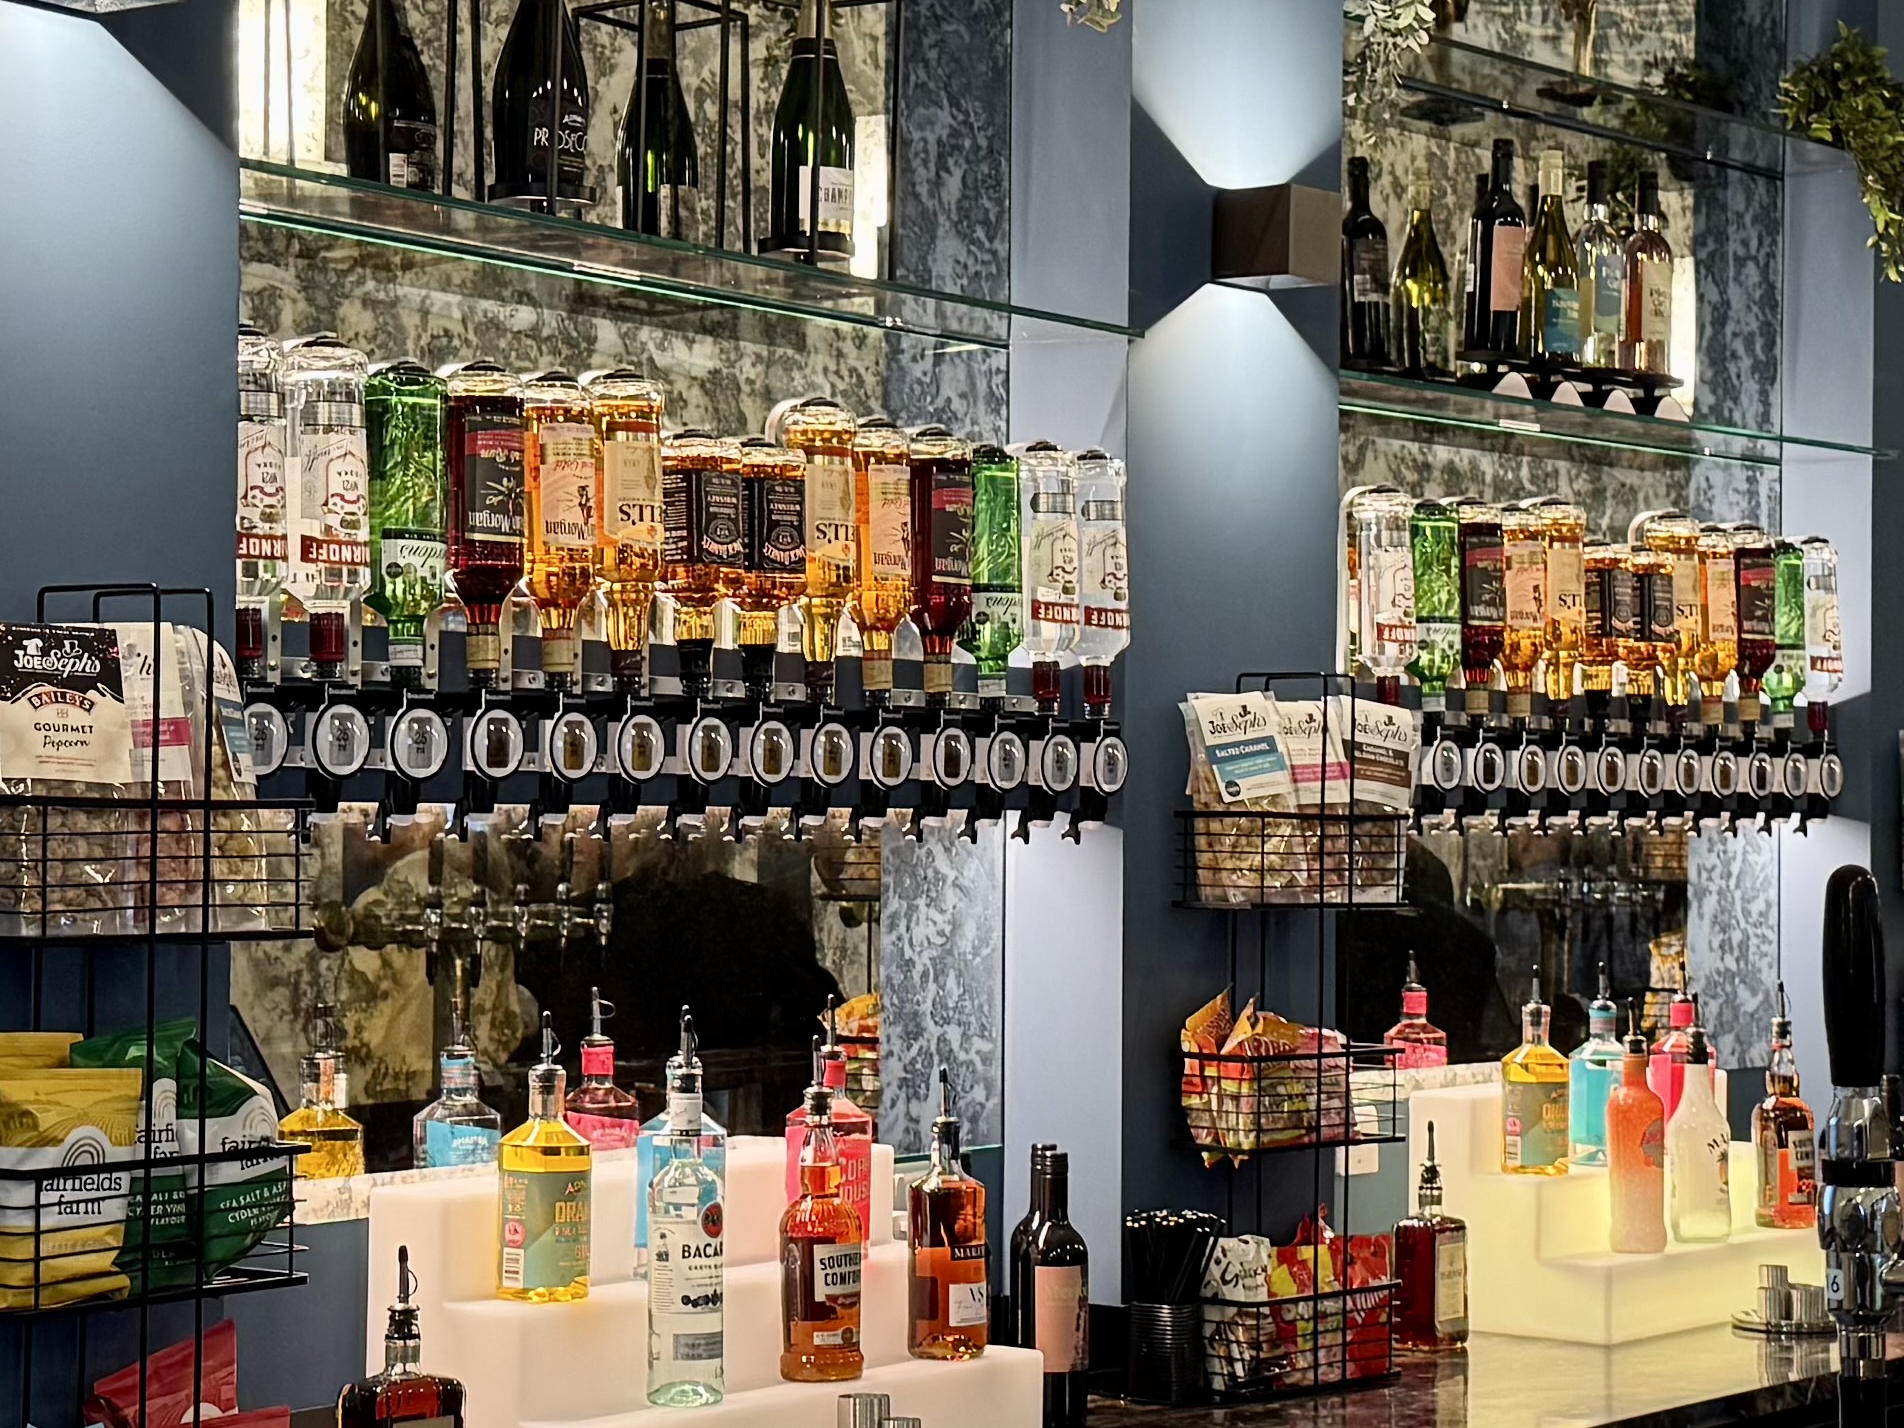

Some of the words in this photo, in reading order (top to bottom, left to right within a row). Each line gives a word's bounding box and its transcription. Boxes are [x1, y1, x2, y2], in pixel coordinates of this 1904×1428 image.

[29, 690, 93, 712] BAILEYS
[34, 722, 94, 734] GOURMET
[43, 735, 90, 751] Popcorn
[1829, 1274, 1840, 1295] 6
